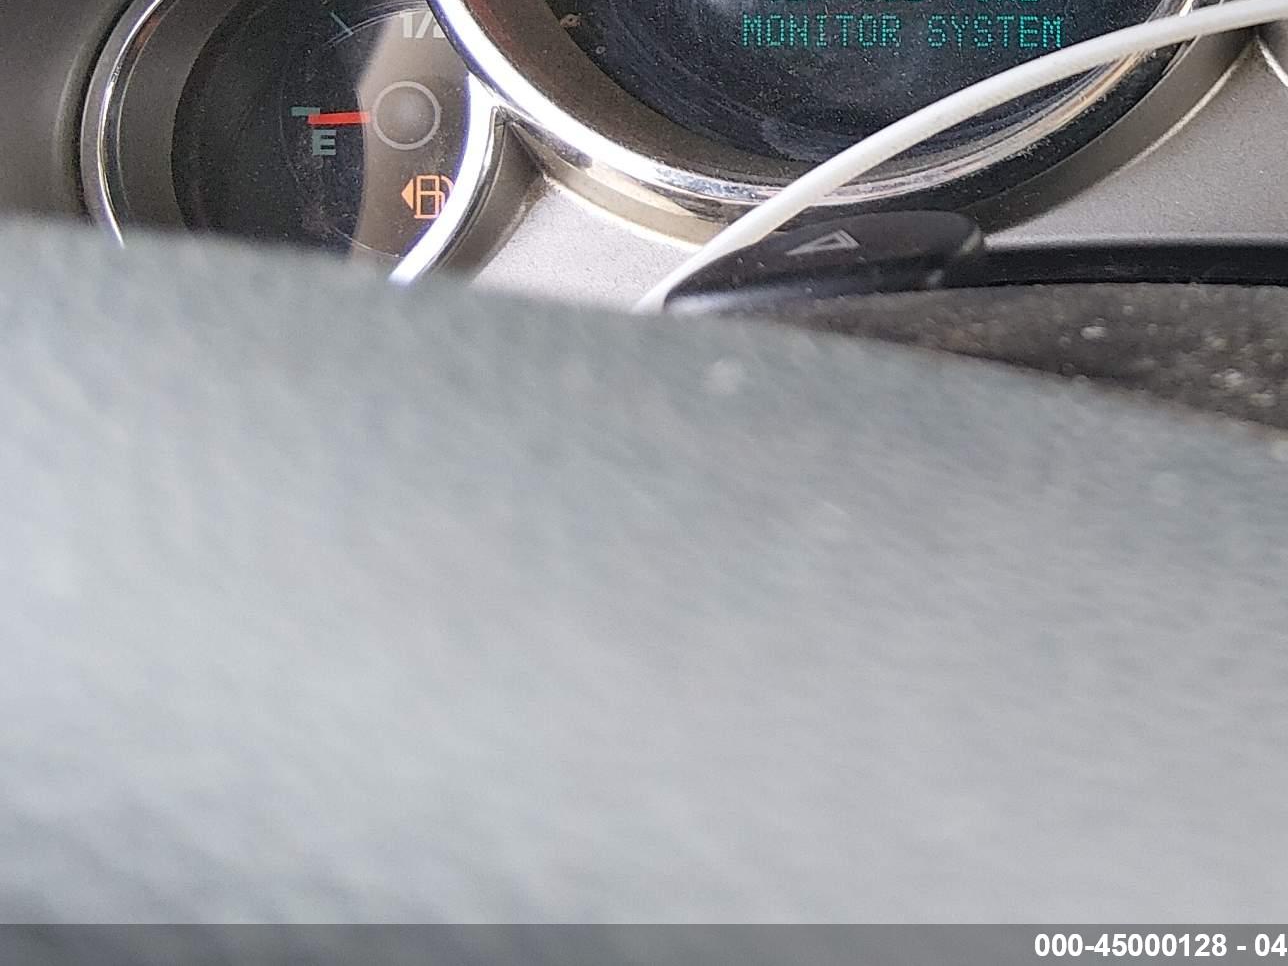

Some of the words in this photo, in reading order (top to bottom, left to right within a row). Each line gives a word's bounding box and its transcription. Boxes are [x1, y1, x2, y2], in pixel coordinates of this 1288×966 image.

[742, 15, 901, 48] MONITOR
[927, 15, 1063, 49] SYSTEM
[312, 129, 336, 155] E
